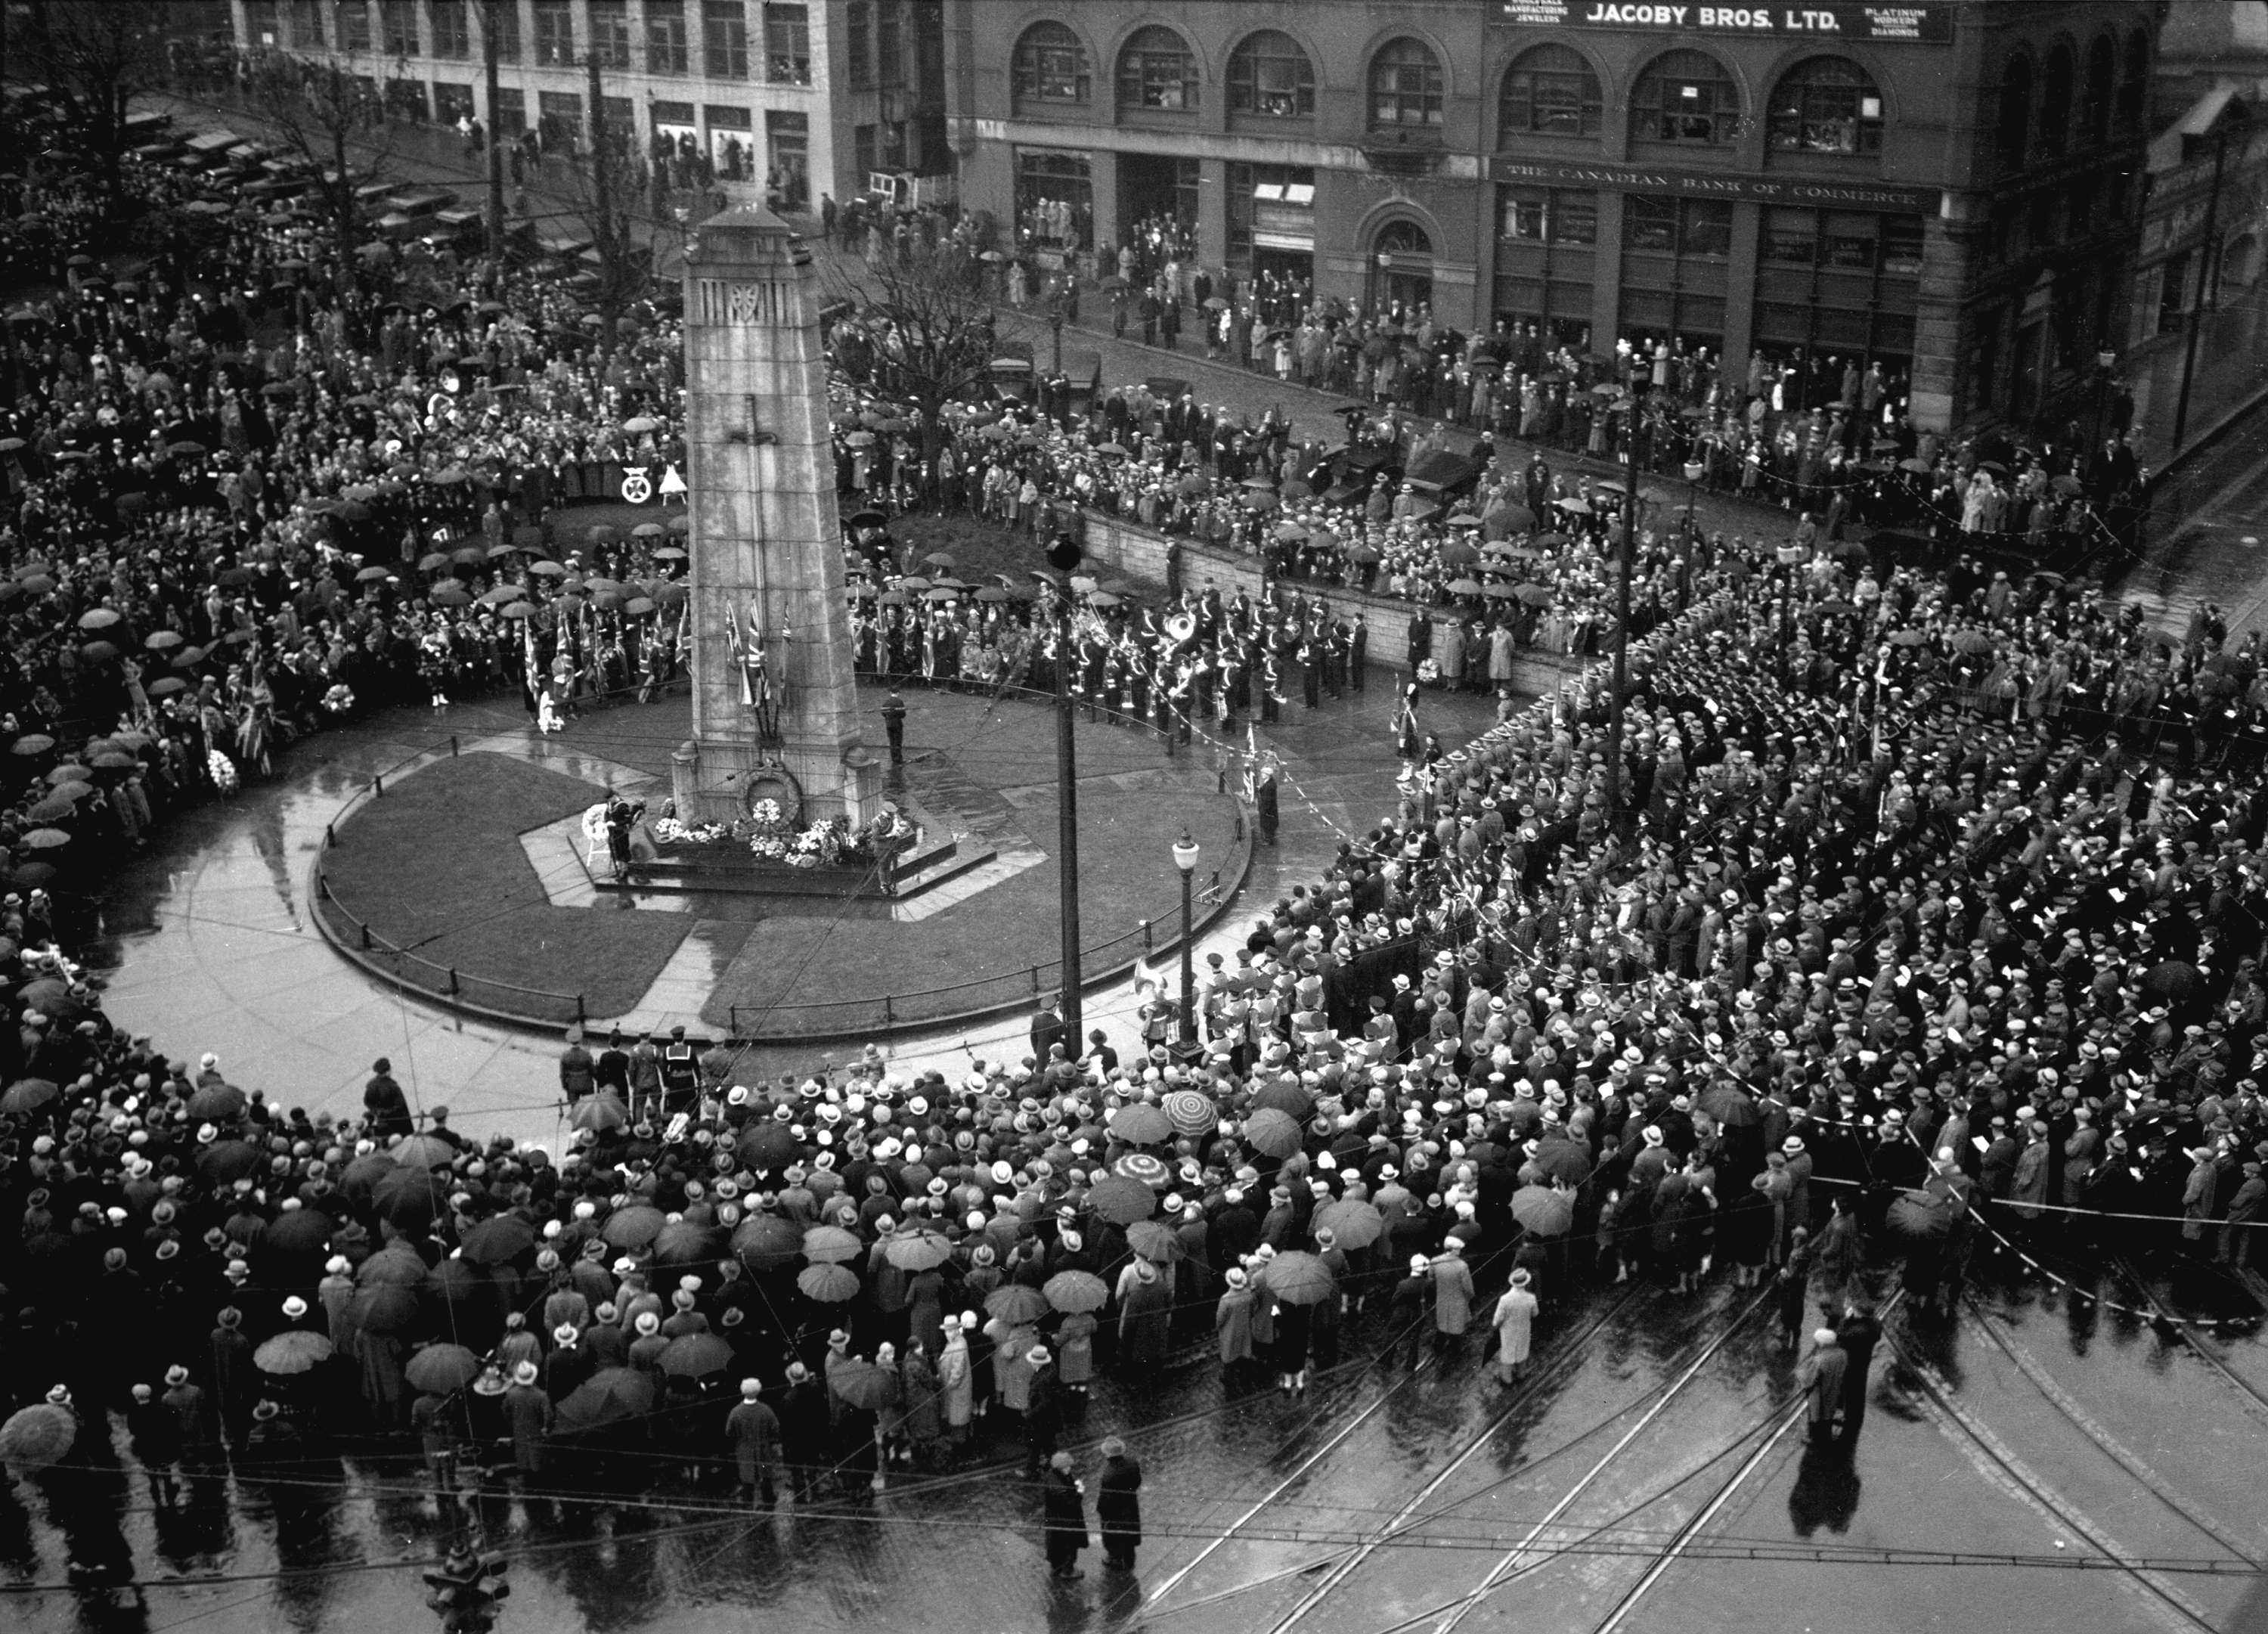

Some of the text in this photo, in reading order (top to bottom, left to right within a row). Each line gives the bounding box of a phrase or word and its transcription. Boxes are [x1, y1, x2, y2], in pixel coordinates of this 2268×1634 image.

[1587, 4, 1841, 30] JACOBY BROS. LTD.
[1864, 8, 1926, 17] PLATINUM
[1507, 164, 1918, 205] THE CANADIAN BANK OF COMMERCE
